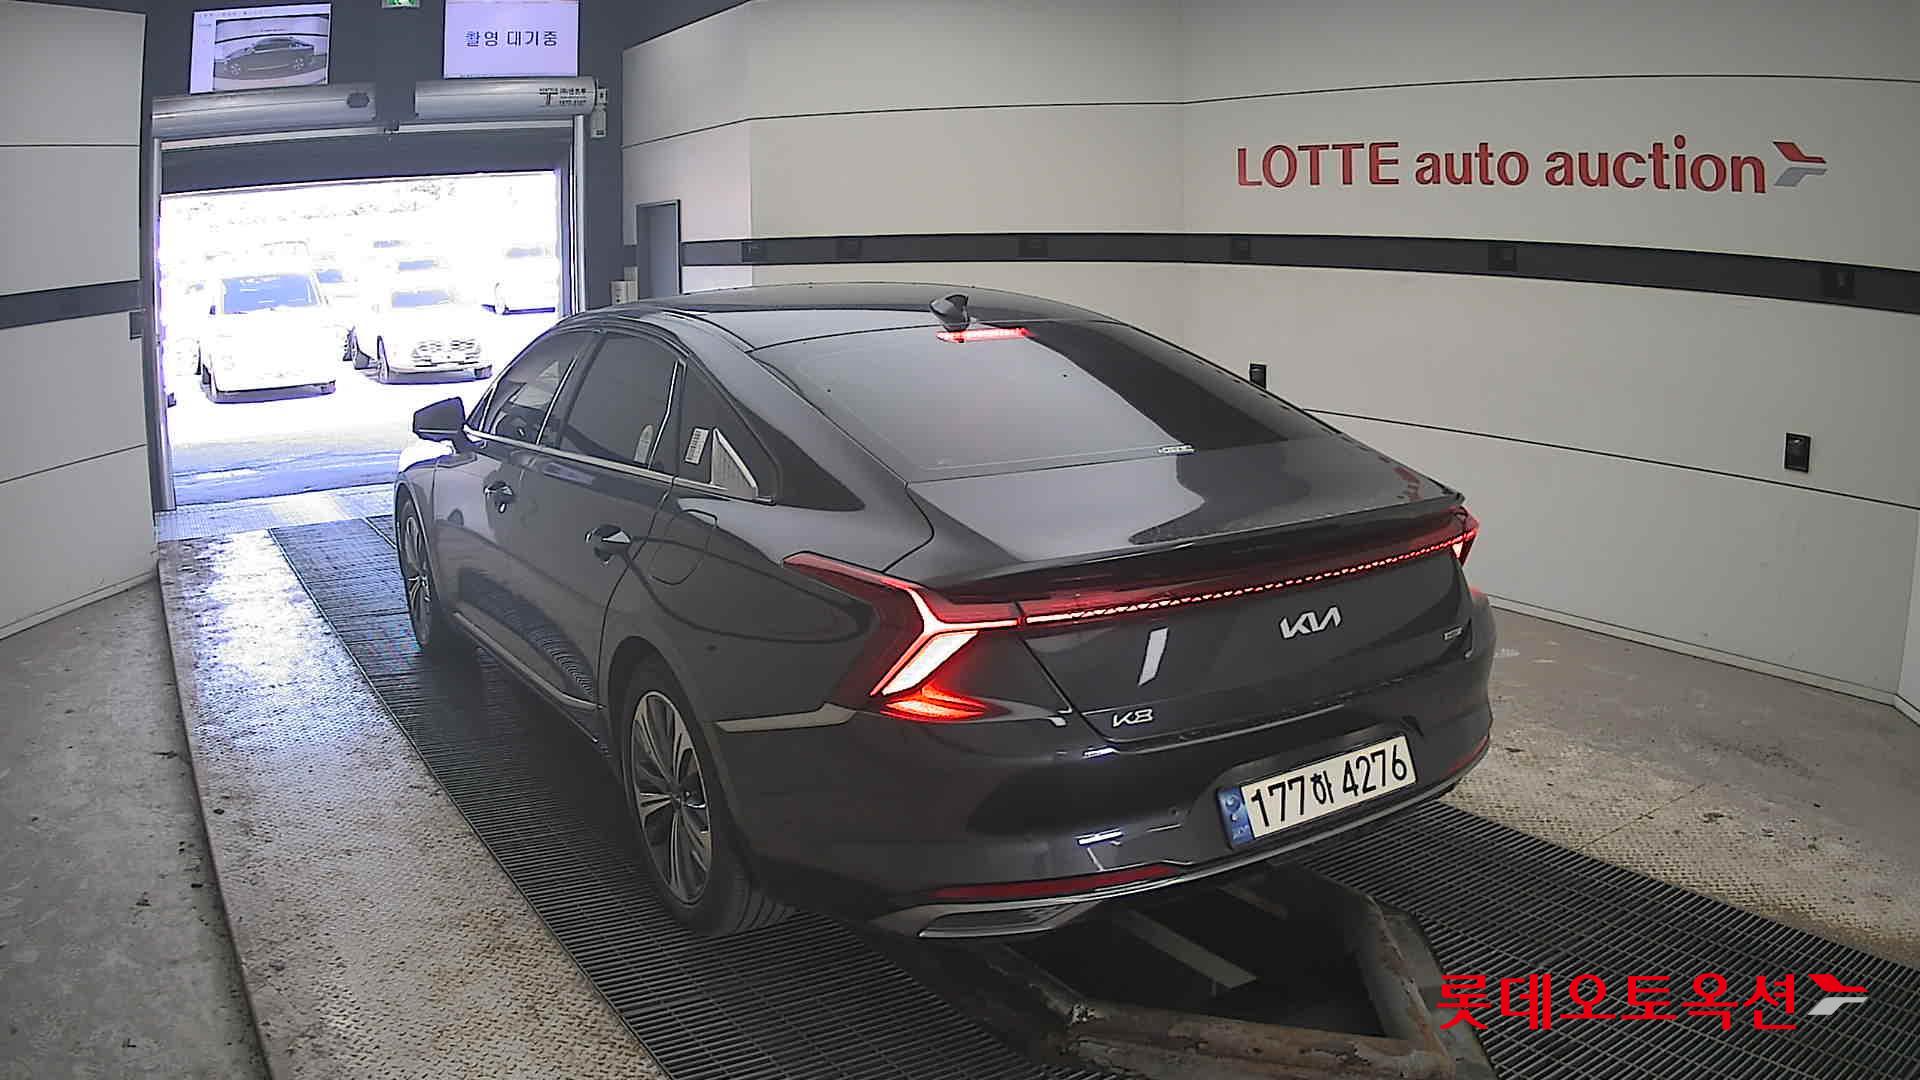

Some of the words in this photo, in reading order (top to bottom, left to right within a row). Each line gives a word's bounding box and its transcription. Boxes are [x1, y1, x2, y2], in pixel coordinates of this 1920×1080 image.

[506, 31, 558, 47] 대기중
[1236, 141, 1399, 188] LOTTE
[1415, 142, 1529, 186] auto
[1545, 134, 1766, 194] auction
[1279, 605, 1342, 640] KIA
[1112, 708, 1154, 727] K8
[1251, 770, 1334, 827] 177하
[1342, 744, 1407, 797] 4276
